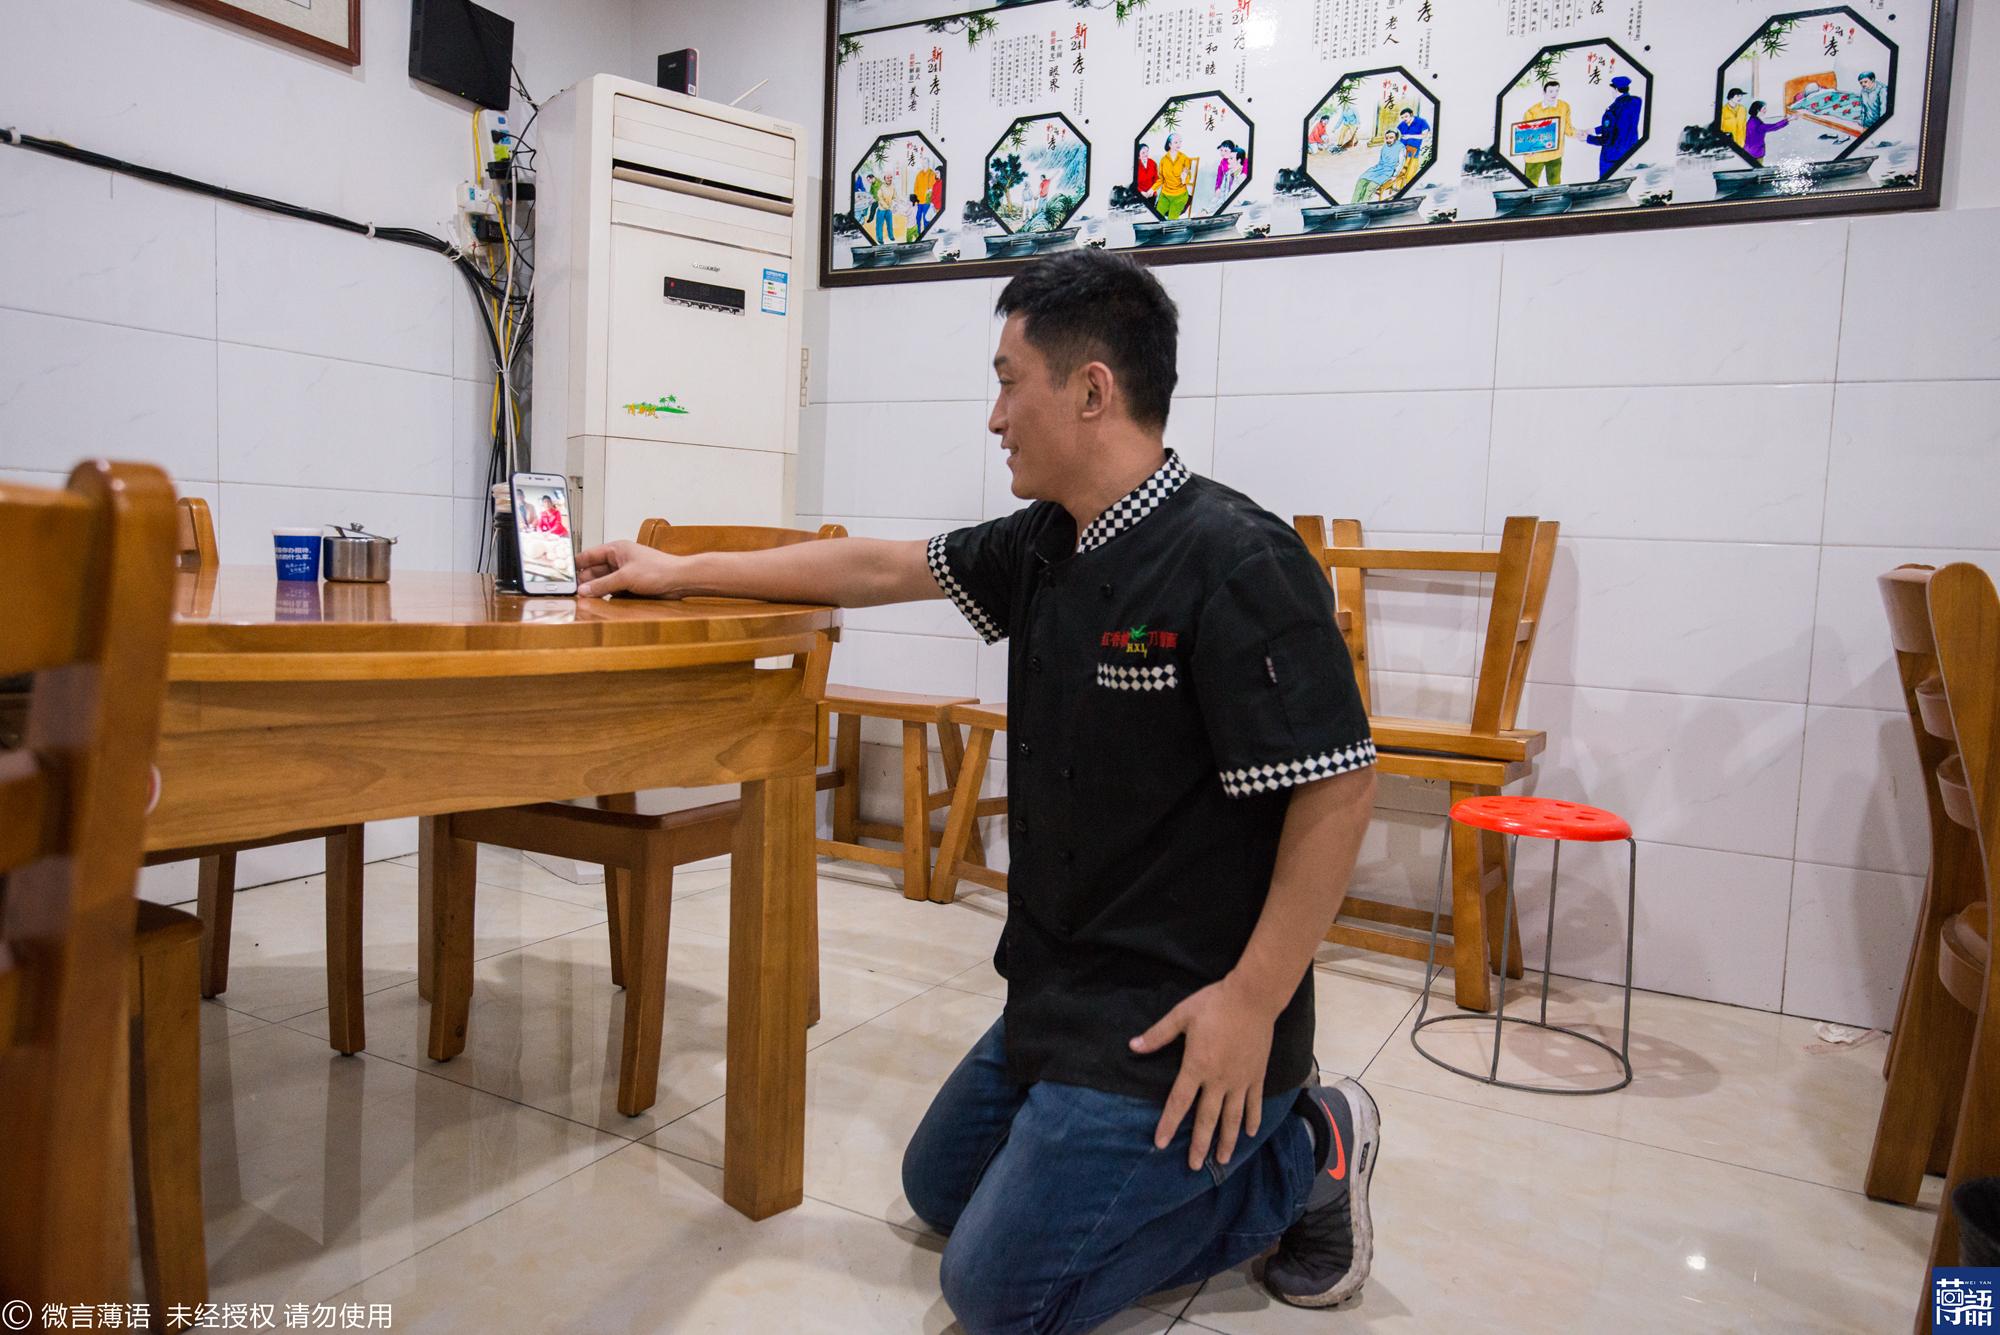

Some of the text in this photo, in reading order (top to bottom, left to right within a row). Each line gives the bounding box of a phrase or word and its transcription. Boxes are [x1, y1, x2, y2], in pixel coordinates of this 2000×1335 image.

[1384, 16, 1400, 45] 老人
[1069, 22, 1088, 74] 新24孝
[1205, 42, 1218, 76] 和睦
[927, 46, 943, 96] 新24孝
[1049, 66, 1060, 93] 眼界
[908, 86, 920, 112] 养老
